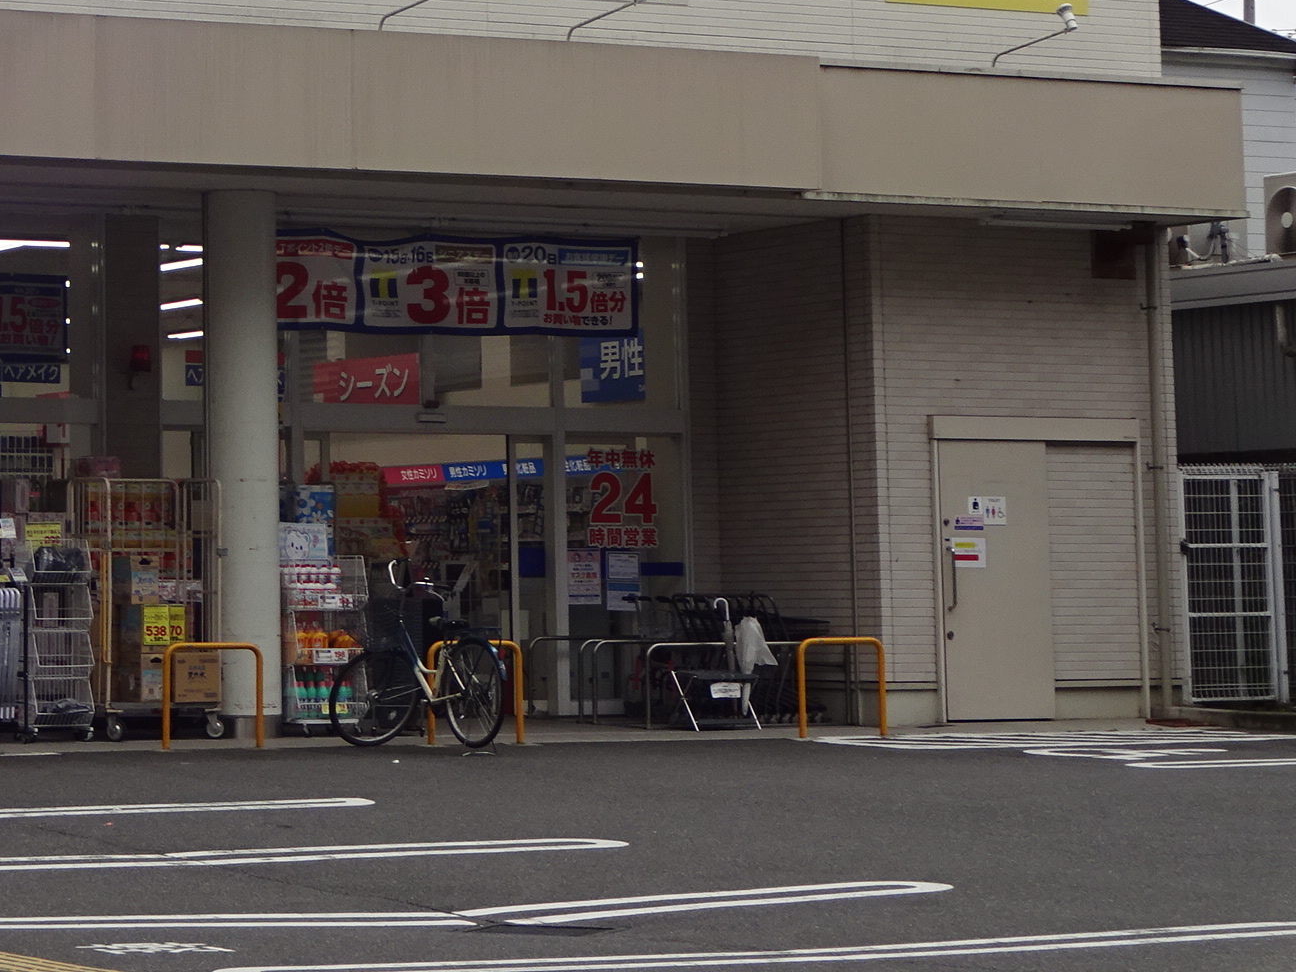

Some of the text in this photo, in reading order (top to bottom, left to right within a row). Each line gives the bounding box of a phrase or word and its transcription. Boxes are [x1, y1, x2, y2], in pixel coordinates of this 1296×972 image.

[599, 337, 644, 380] 男性
[4, 364, 59, 381] ヘアメイク
[338, 363, 409, 401] シーズン
[587, 448, 656, 469] 年中無休
[400, 464, 487, 481] 女性カミソリ 男性カミソリ
[590, 471, 658, 524] 24
[588, 527, 658, 547] 時間営業
[146, 625, 167, 636] 538
